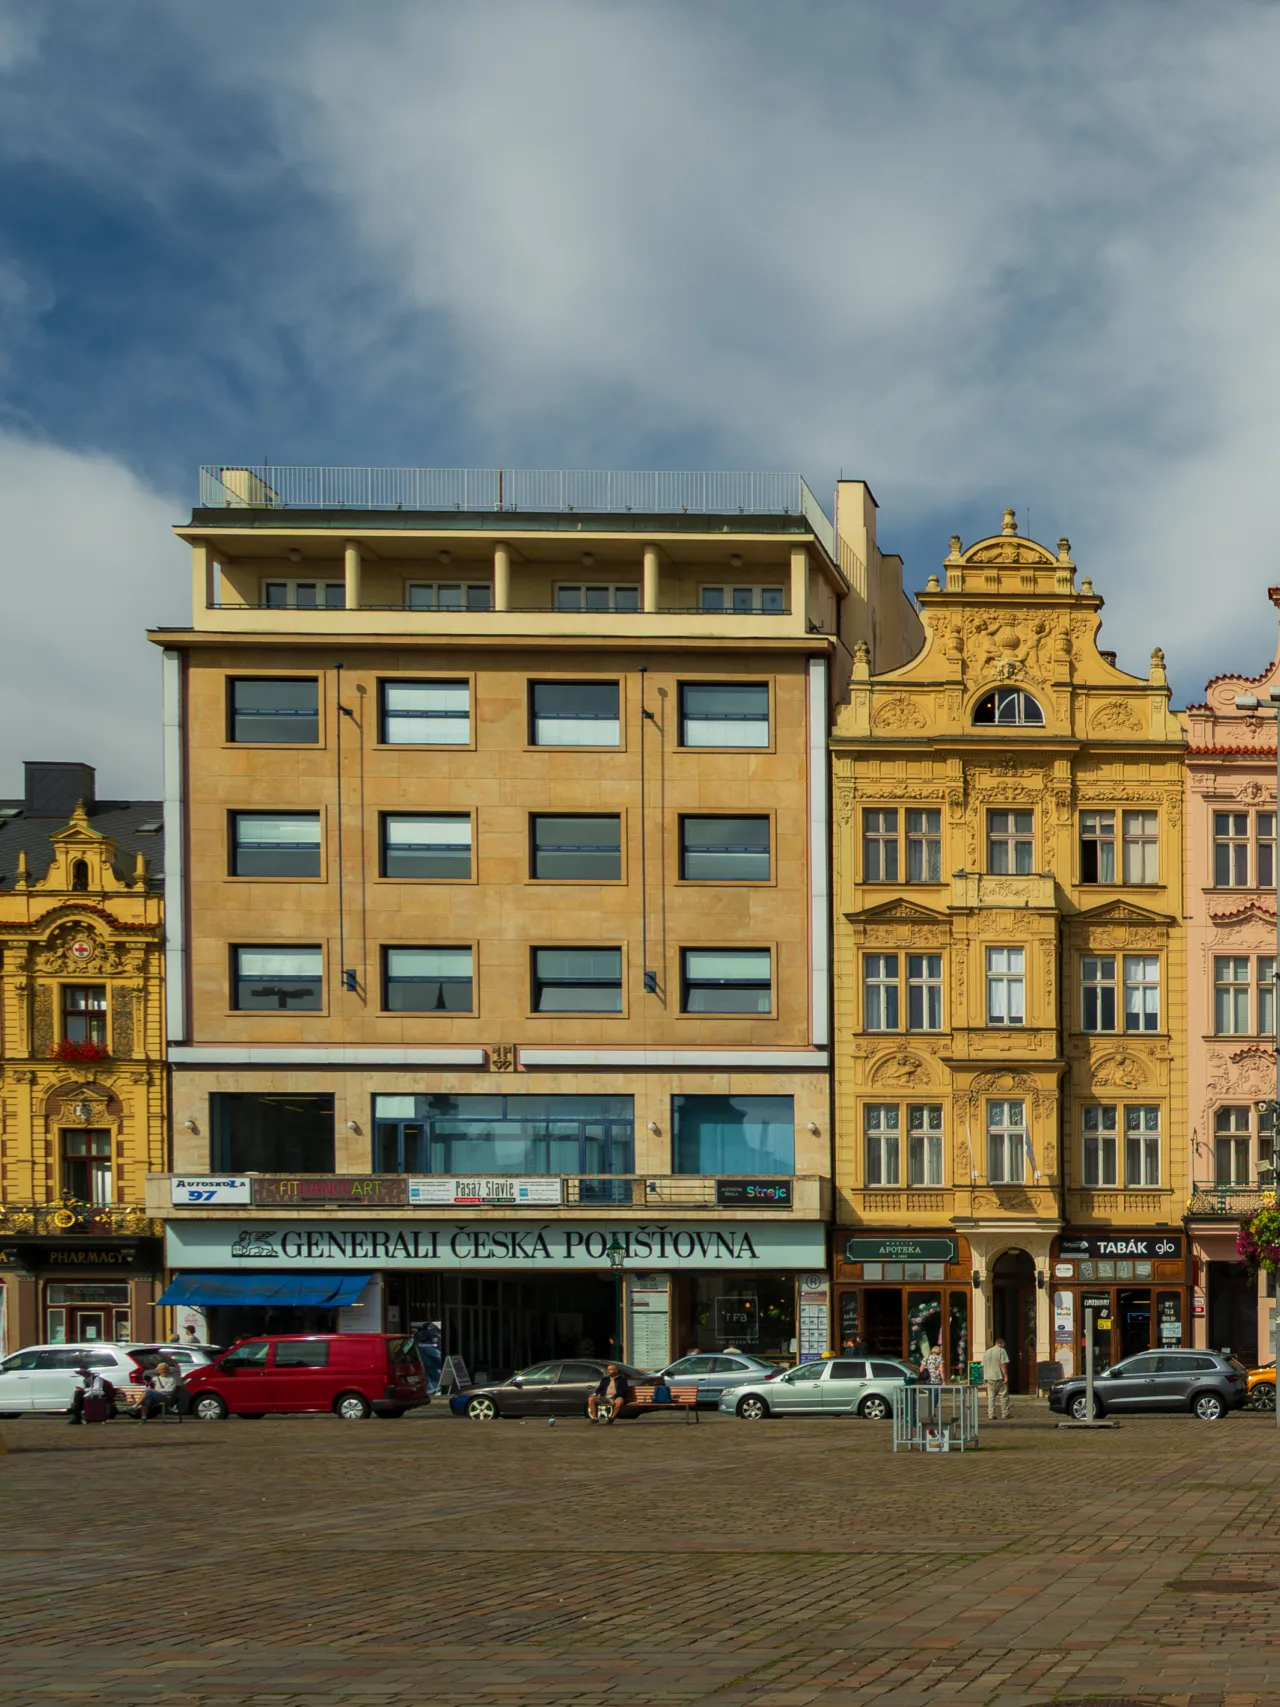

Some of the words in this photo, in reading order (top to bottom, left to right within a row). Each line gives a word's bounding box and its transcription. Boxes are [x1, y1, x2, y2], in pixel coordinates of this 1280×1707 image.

[455, 1180, 481, 1196] Pasáž
[486, 1180, 514, 1196] Slavie
[746, 1186, 787, 1199] Strejc
[188, 1190, 218, 1201] 97
[281, 1230, 441, 1258] GENERALI
[450, 1225, 554, 1258] ČESKÁ
[1097, 1239, 1148, 1254] TABÁK
[1155, 1239, 1175, 1254] glo
[879, 1246, 921, 1254] APOTEKA
[49, 1251, 123, 1263] PHARMACY
